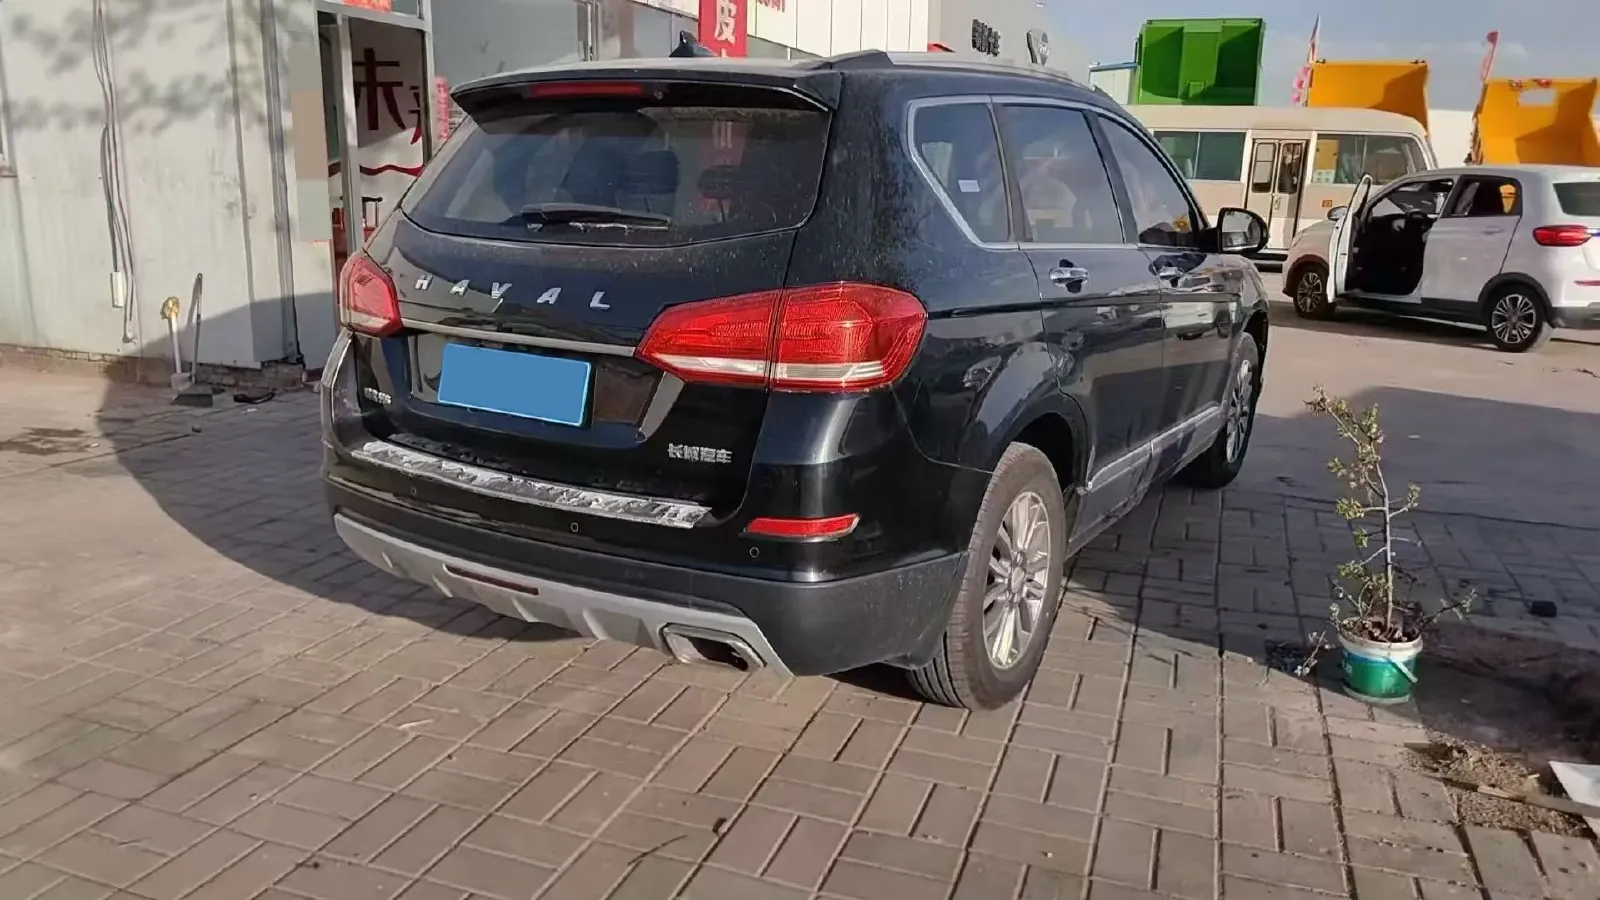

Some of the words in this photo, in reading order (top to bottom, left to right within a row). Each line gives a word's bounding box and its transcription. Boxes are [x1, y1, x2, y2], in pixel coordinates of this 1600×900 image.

[414, 274, 611, 310] HAVAL
[667, 442, 733, 464] 长城汽车
